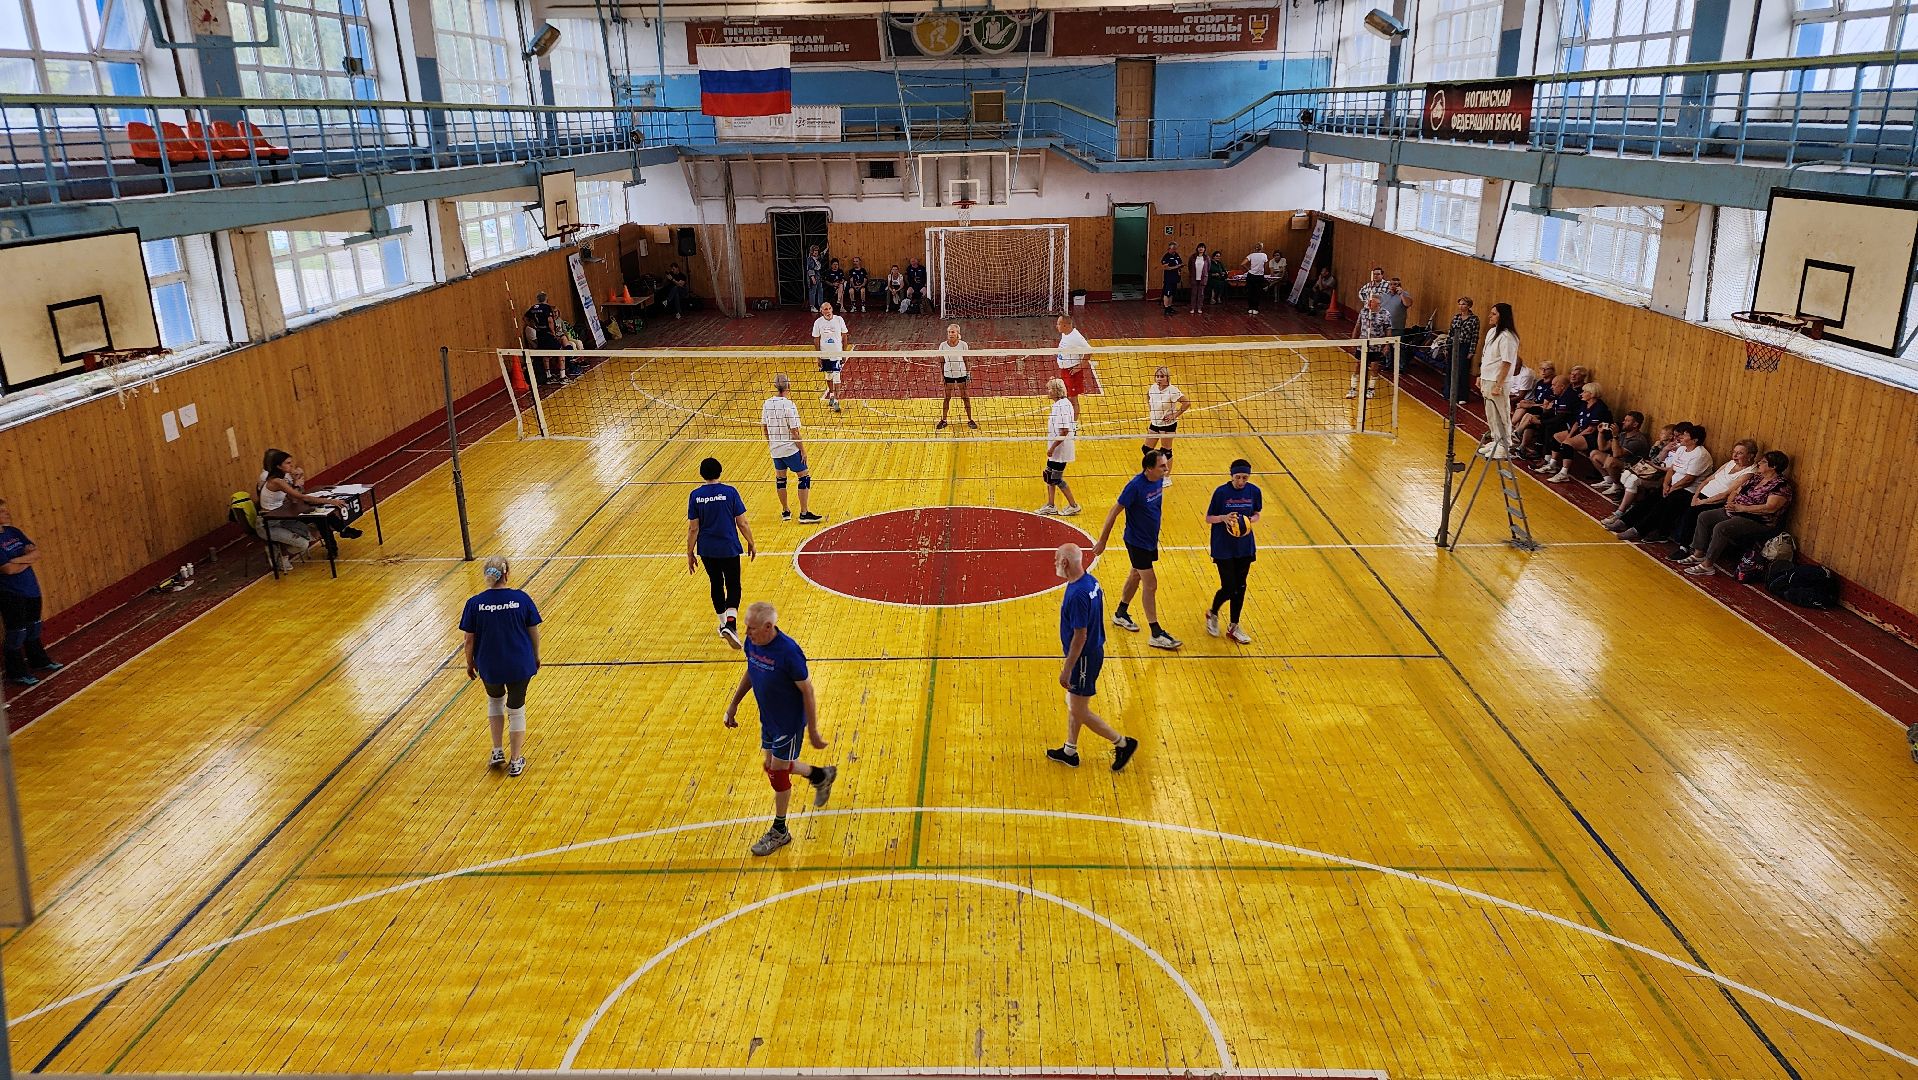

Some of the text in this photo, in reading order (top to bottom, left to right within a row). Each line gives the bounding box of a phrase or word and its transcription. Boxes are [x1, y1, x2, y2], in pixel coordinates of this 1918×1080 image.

[722, 26, 784, 36] ПРИВЕТ
[1106, 24, 1242, 34] ИСТОЧНИК СИЛЫ
[1138, 33, 1241, 44] И ЗДОРОВЬЯ!
[790, 41, 850, 53] ОВАНИЙ!
[1464, 89, 1512, 108] НОГИНСКАЯ
[1451, 113, 1522, 133] ФЕДЕРАЦИЯ БОКСА
[341, 507, 349, 520] 9
[353, 499, 360, 513] 5
[478, 601, 520, 612] Королёв
